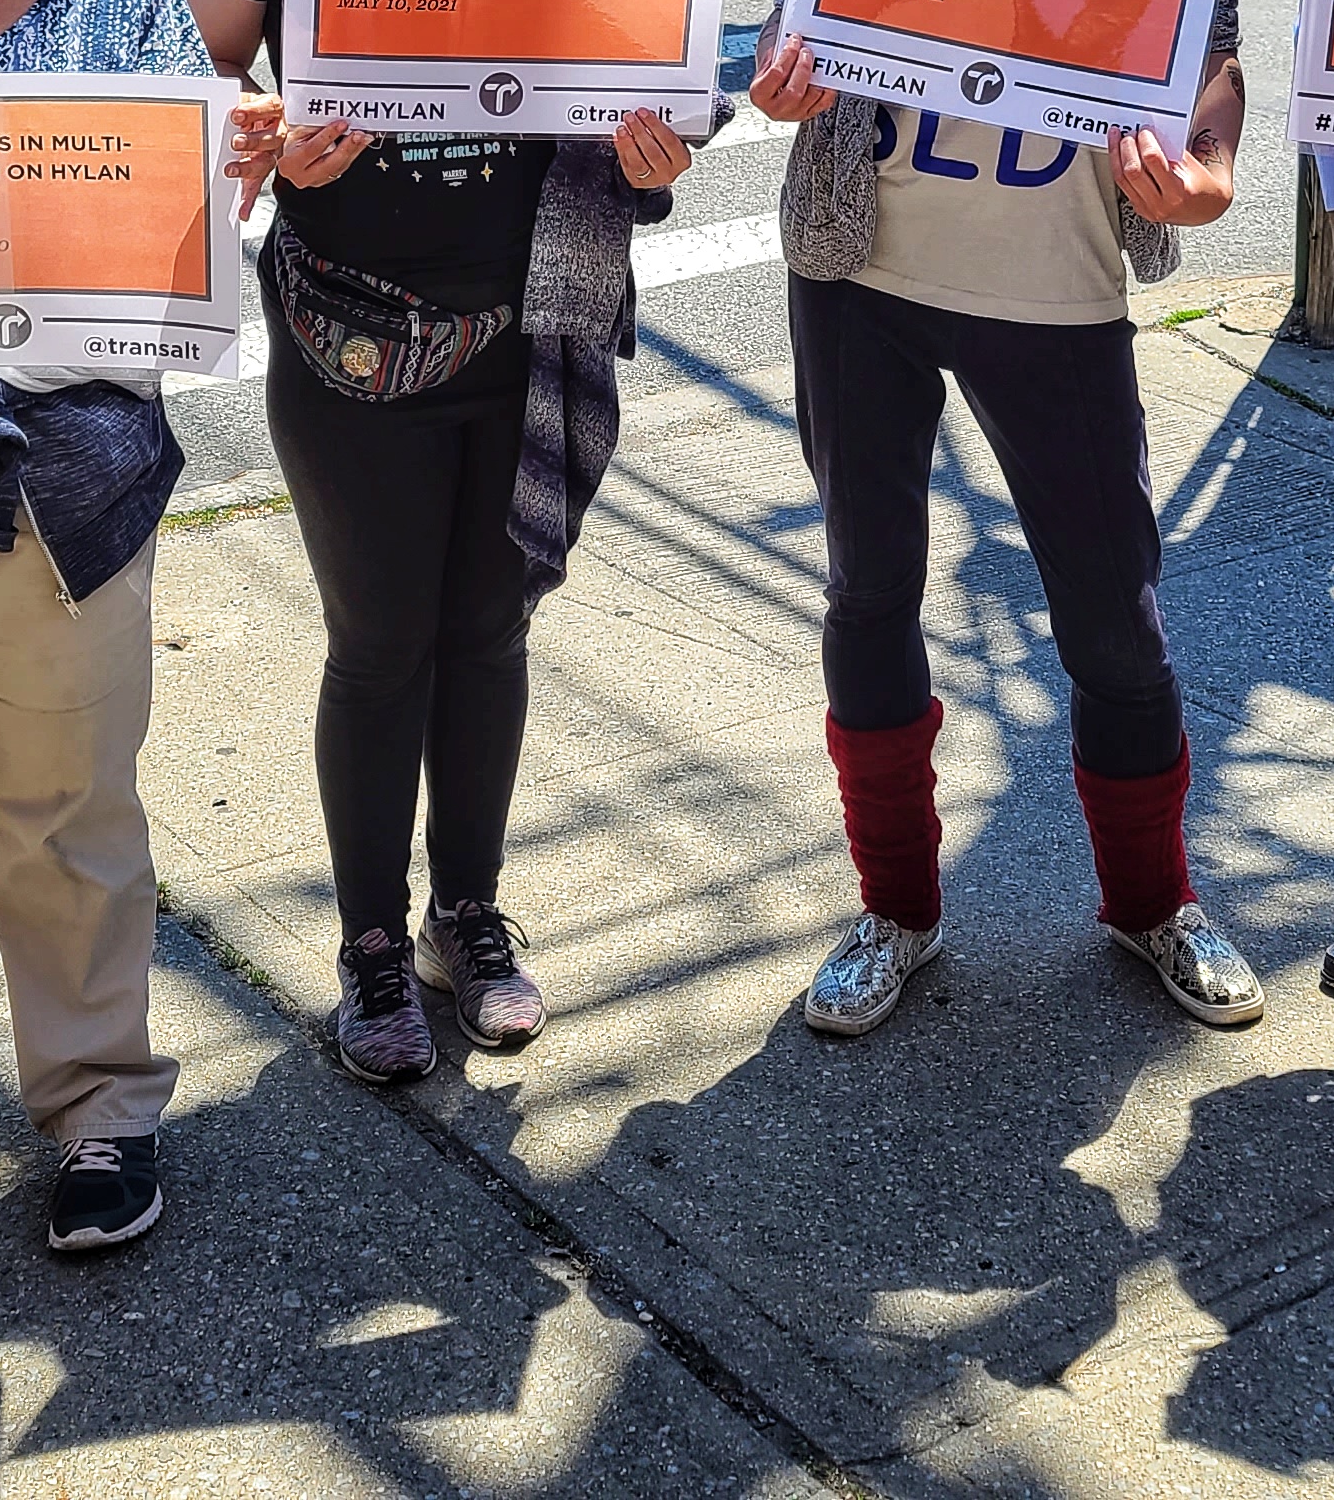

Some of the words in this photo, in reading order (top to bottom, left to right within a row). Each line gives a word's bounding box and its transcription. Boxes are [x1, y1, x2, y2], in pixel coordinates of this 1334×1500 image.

[812, 56, 927, 97] FIXHYLAN
[307, 98, 446, 121] #FIXHYLAN
[19, 135, 44, 152] IN
[51, 135, 132, 153] MULTI-
[401, 148, 439, 161] WHAT
[443, 144, 481, 159] GIRLS
[483, 141, 501, 155] DO
[7, 163, 44, 182] ON
[50, 164, 132, 182] HYLAN
[83, 335, 201, 363] @transalt
